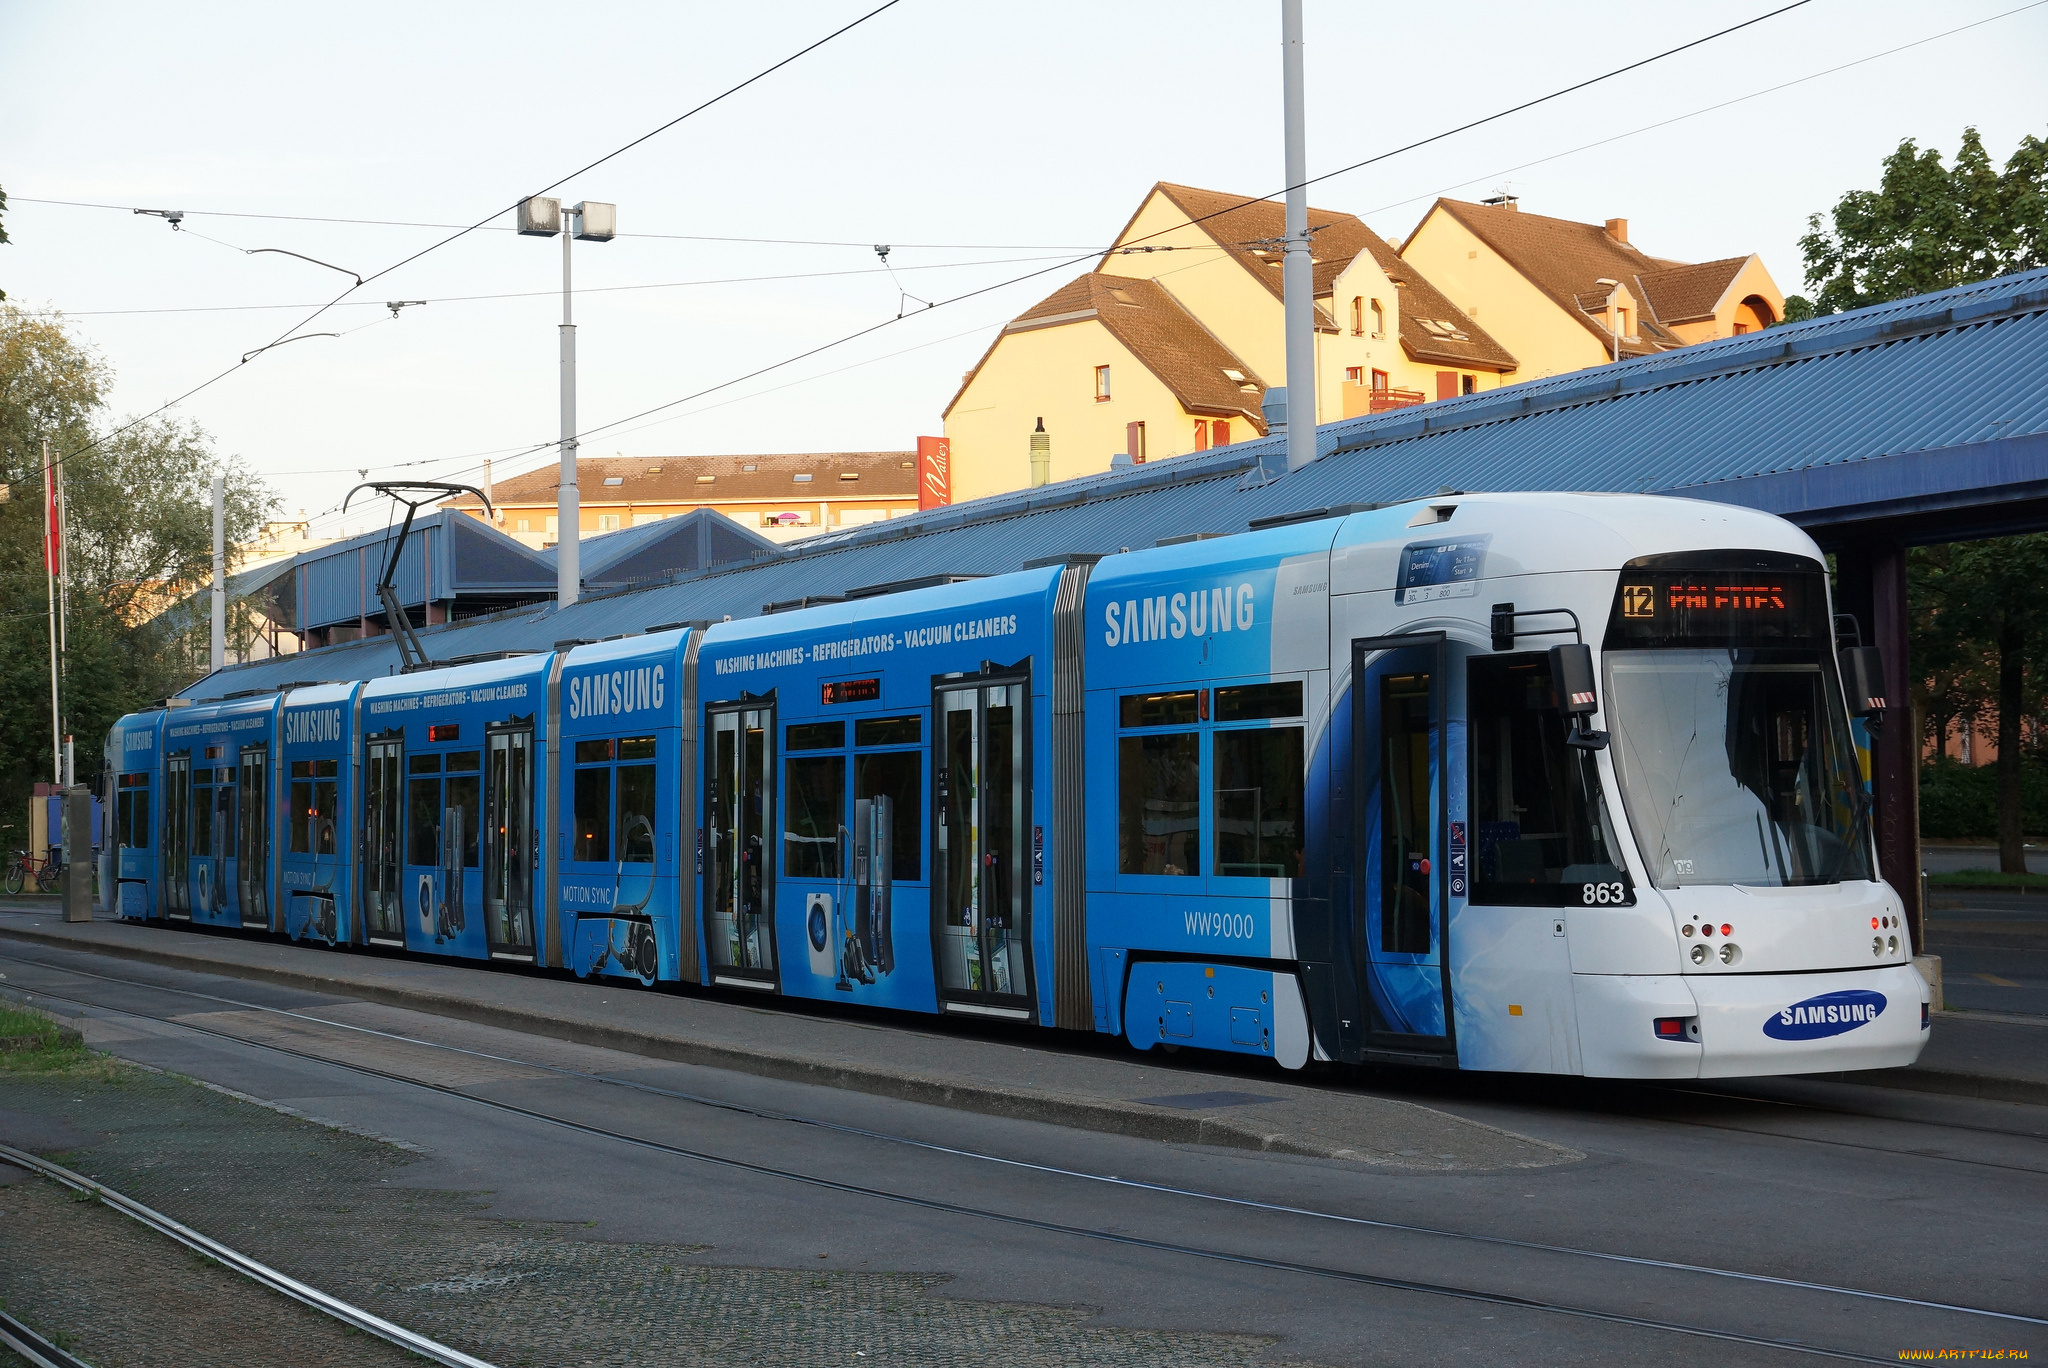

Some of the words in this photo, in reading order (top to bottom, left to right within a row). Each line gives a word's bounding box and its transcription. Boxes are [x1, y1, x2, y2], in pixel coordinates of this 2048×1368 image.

[1292, 581, 1328, 596] SAMSUNG
[1624, 586, 1654, 617] 12
[1105, 582, 1254, 648] SAMSUNG
[715, 655, 755, 676] WASHING
[756, 646, 804, 670] MACHINES
[812, 633, 895, 662] REFRIGERATORS
[904, 621, 951, 648] VACUUM
[954, 614, 1017, 642] CLEANERS
[370, 701, 393, 714] WASHING
[393, 697, 419, 712] MACHINES
[423, 692, 466, 708] REFRIGERATORS
[471, 687, 496, 703] VACUUM
[496, 683, 527, 701] CLEANERS
[569, 664, 665, 719] SAMSUNG
[126, 730, 153, 752] SAMSUNG
[286, 708, 340, 745] SAMSUNG
[563, 885, 590, 903] MOTION
[591, 887, 611, 905] SYNC
[1583, 882, 1625, 904] 863
[1184, 911, 1254, 939] WW9000
[1780, 1003, 1877, 1026] SAMSUNG
